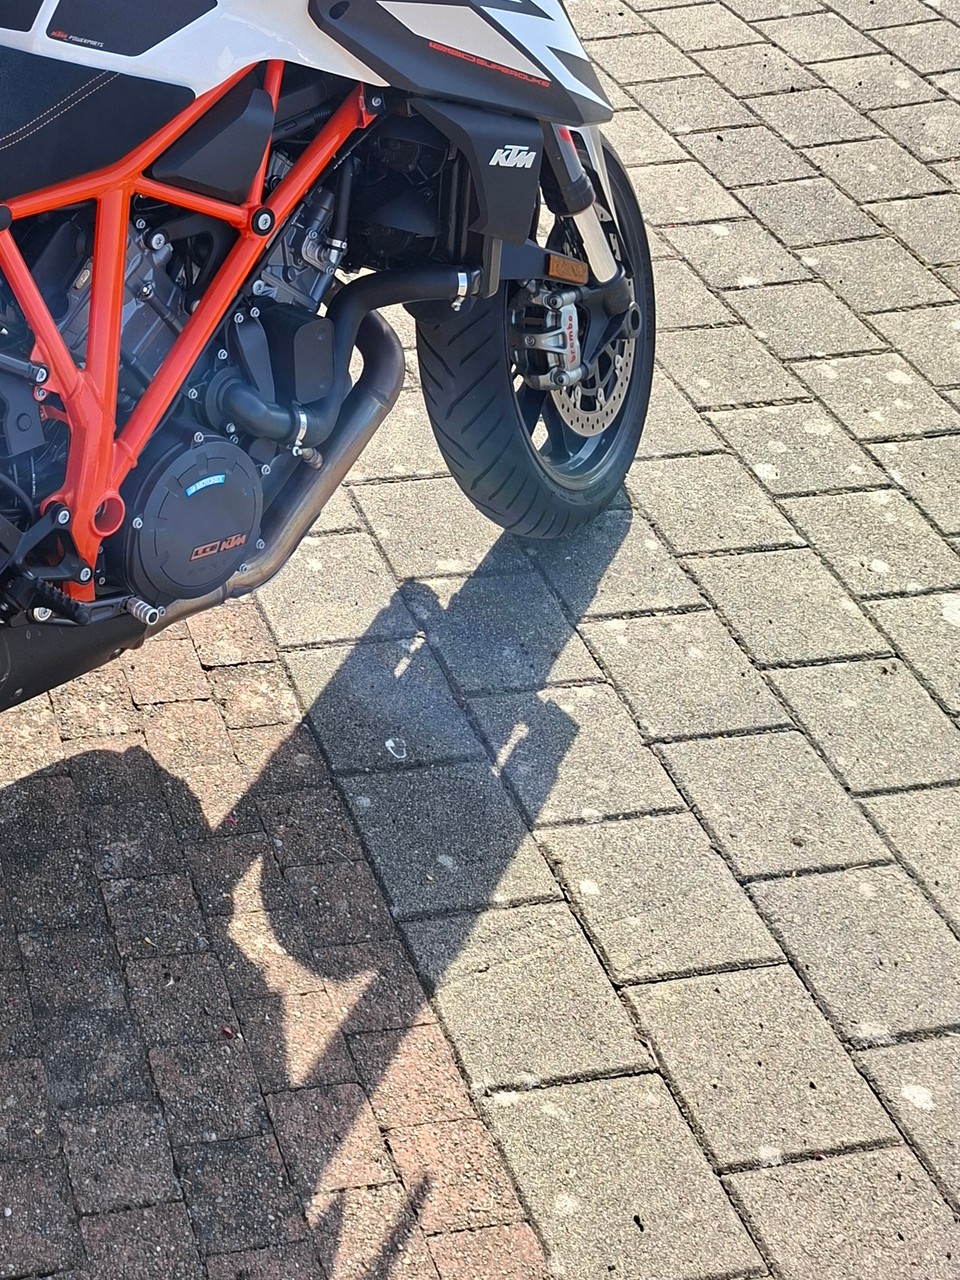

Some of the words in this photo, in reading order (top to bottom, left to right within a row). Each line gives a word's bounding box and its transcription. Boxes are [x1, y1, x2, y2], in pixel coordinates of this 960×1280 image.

[68, 35, 105, 48] POWERPARTS
[489, 144, 537, 169] KTM
[567, 315, 577, 363] brembo
[220, 533, 247, 552] KTM
